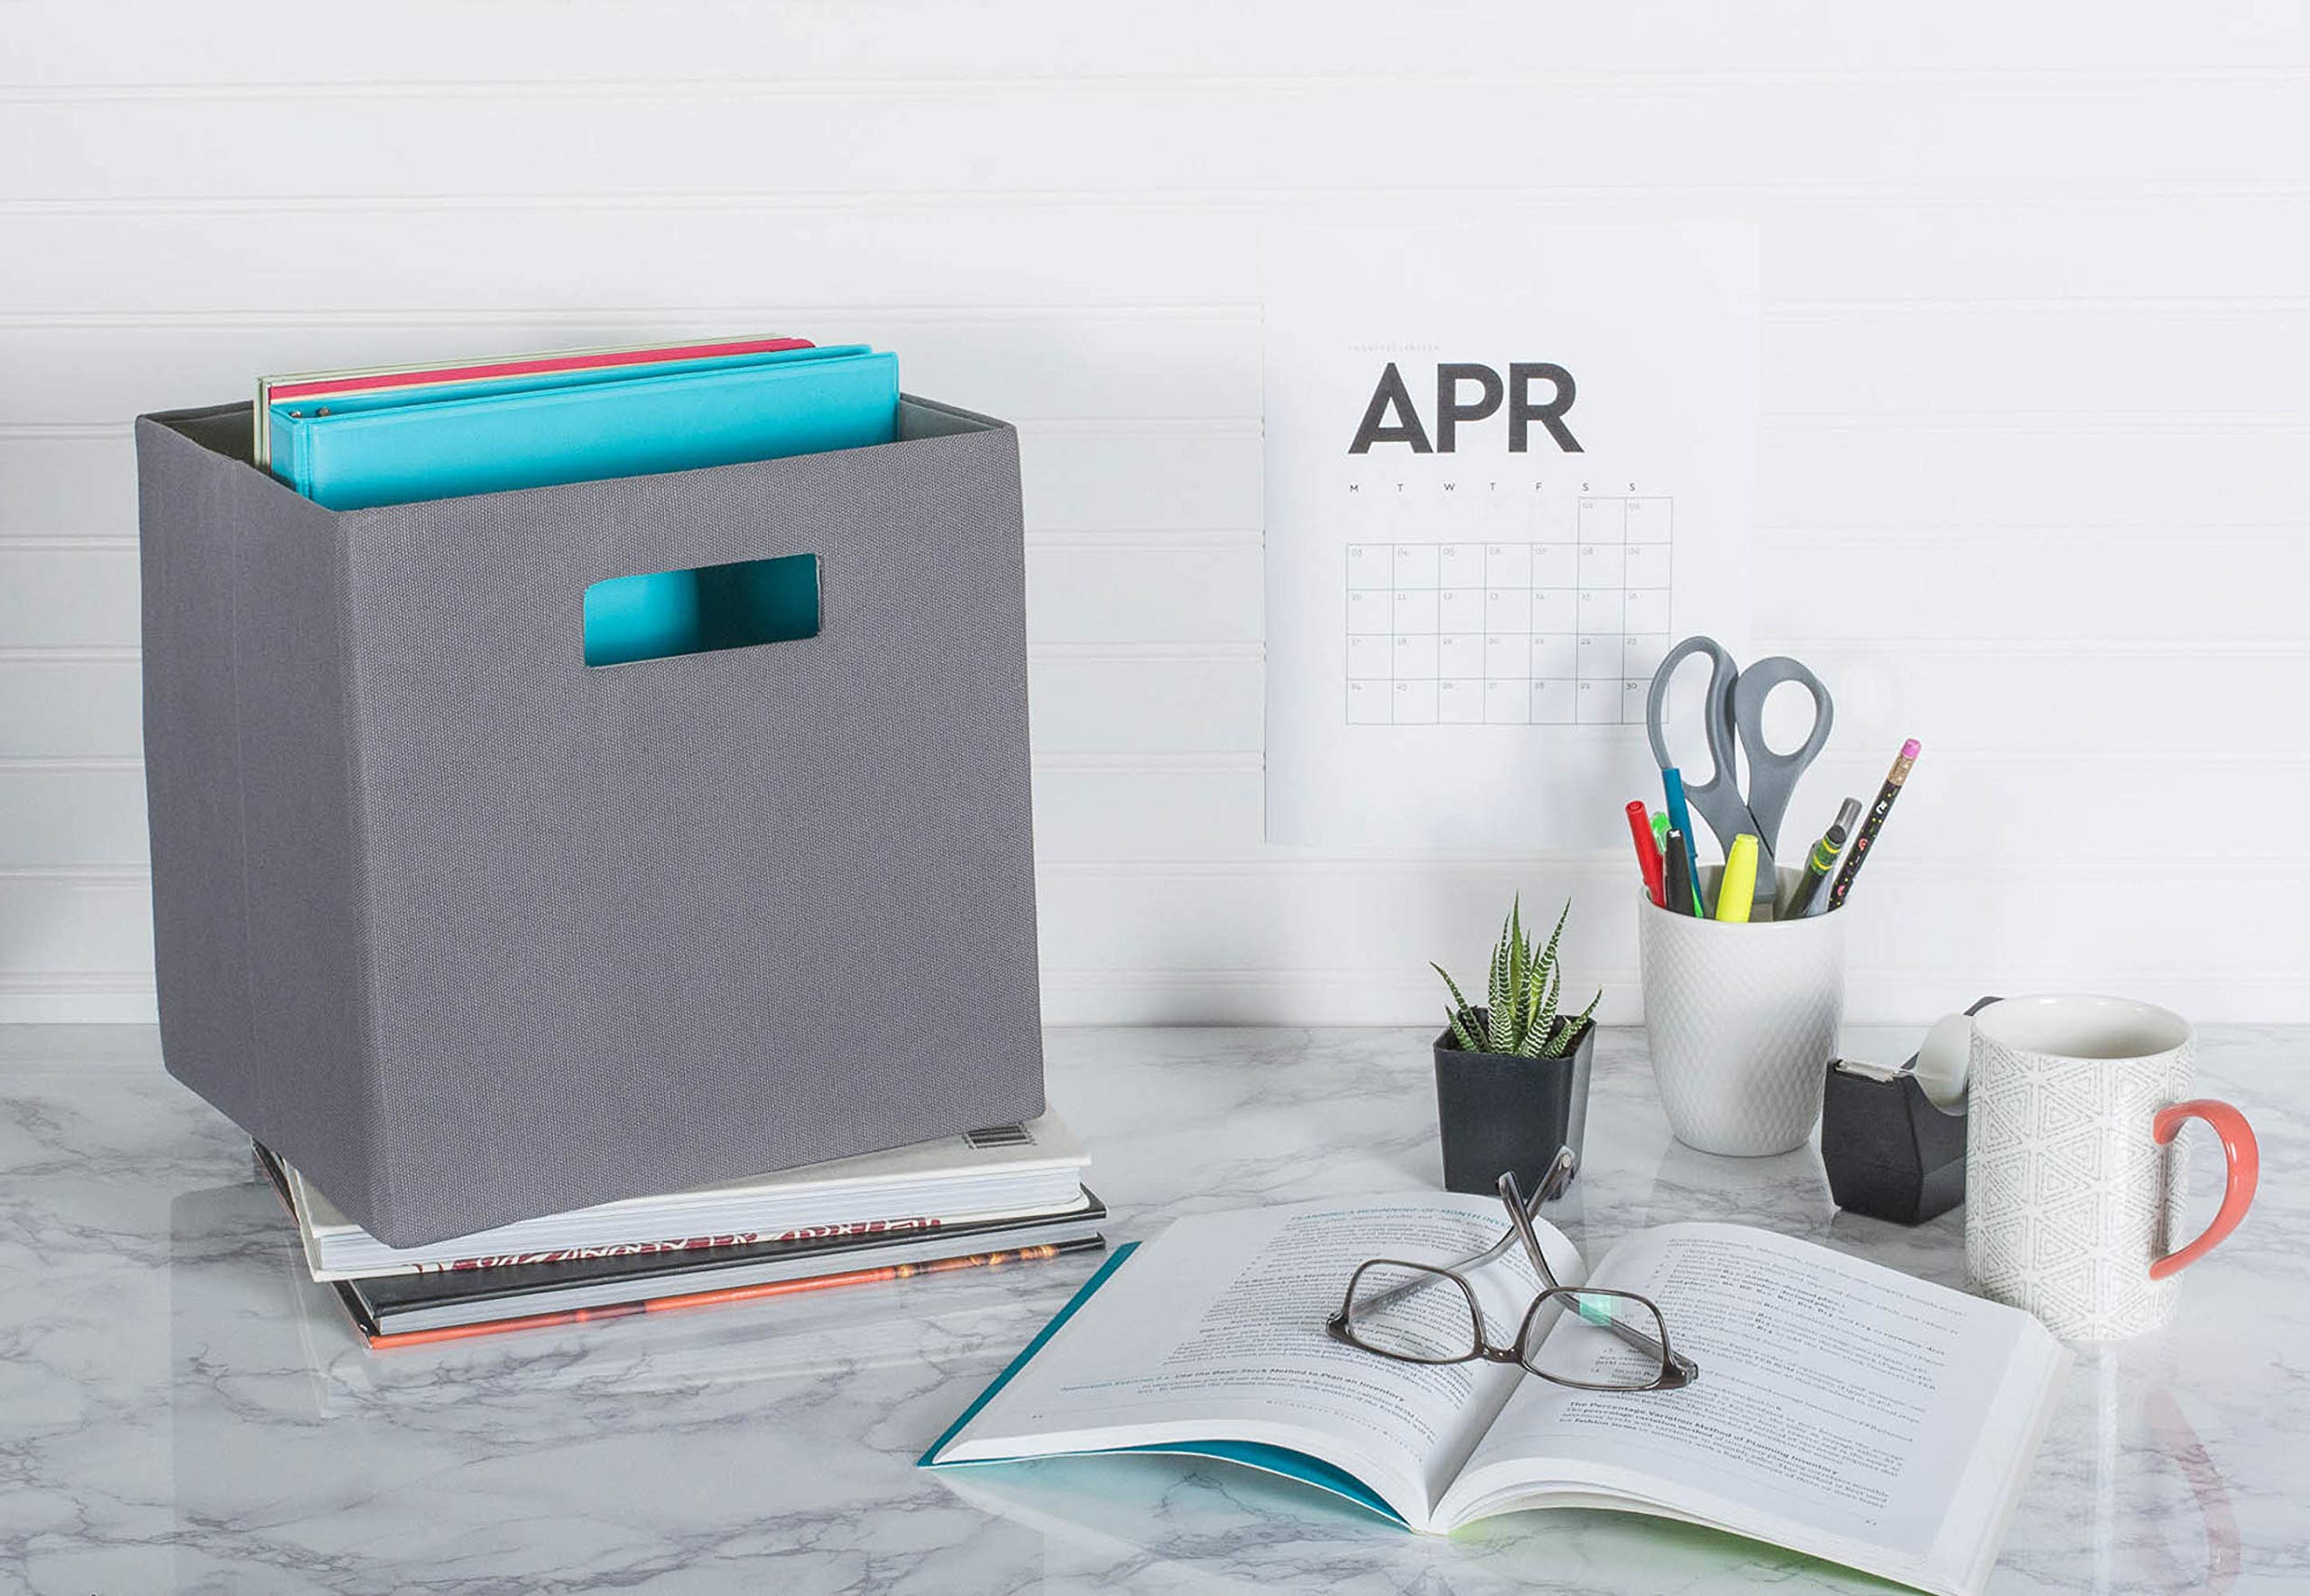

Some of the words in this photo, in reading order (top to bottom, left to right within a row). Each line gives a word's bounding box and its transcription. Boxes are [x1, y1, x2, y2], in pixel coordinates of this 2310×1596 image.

[1348, 362, 1585, 453] APR
[1397, 484, 1404, 492] T
[1444, 483, 1455, 491] W
[1489, 483, 1496, 491] T
[1535, 483, 1542, 491] F
[1583, 483, 1590, 491] S
[1629, 483, 1636, 491] S
[1270, 1367, 1308, 1376] Method
[1320, 1370, 1344, 1381] Plan
[1359, 1379, 1406, 1403] Inventory
[1589, 1402, 1647, 1416] Percentage
[1648, 1410, 1693, 1426] Variation
[1695, 1422, 1732, 1438] Method
[1745, 1437, 1790, 1460] Planning
[1790, 1454, 1839, 1476] Inventory
